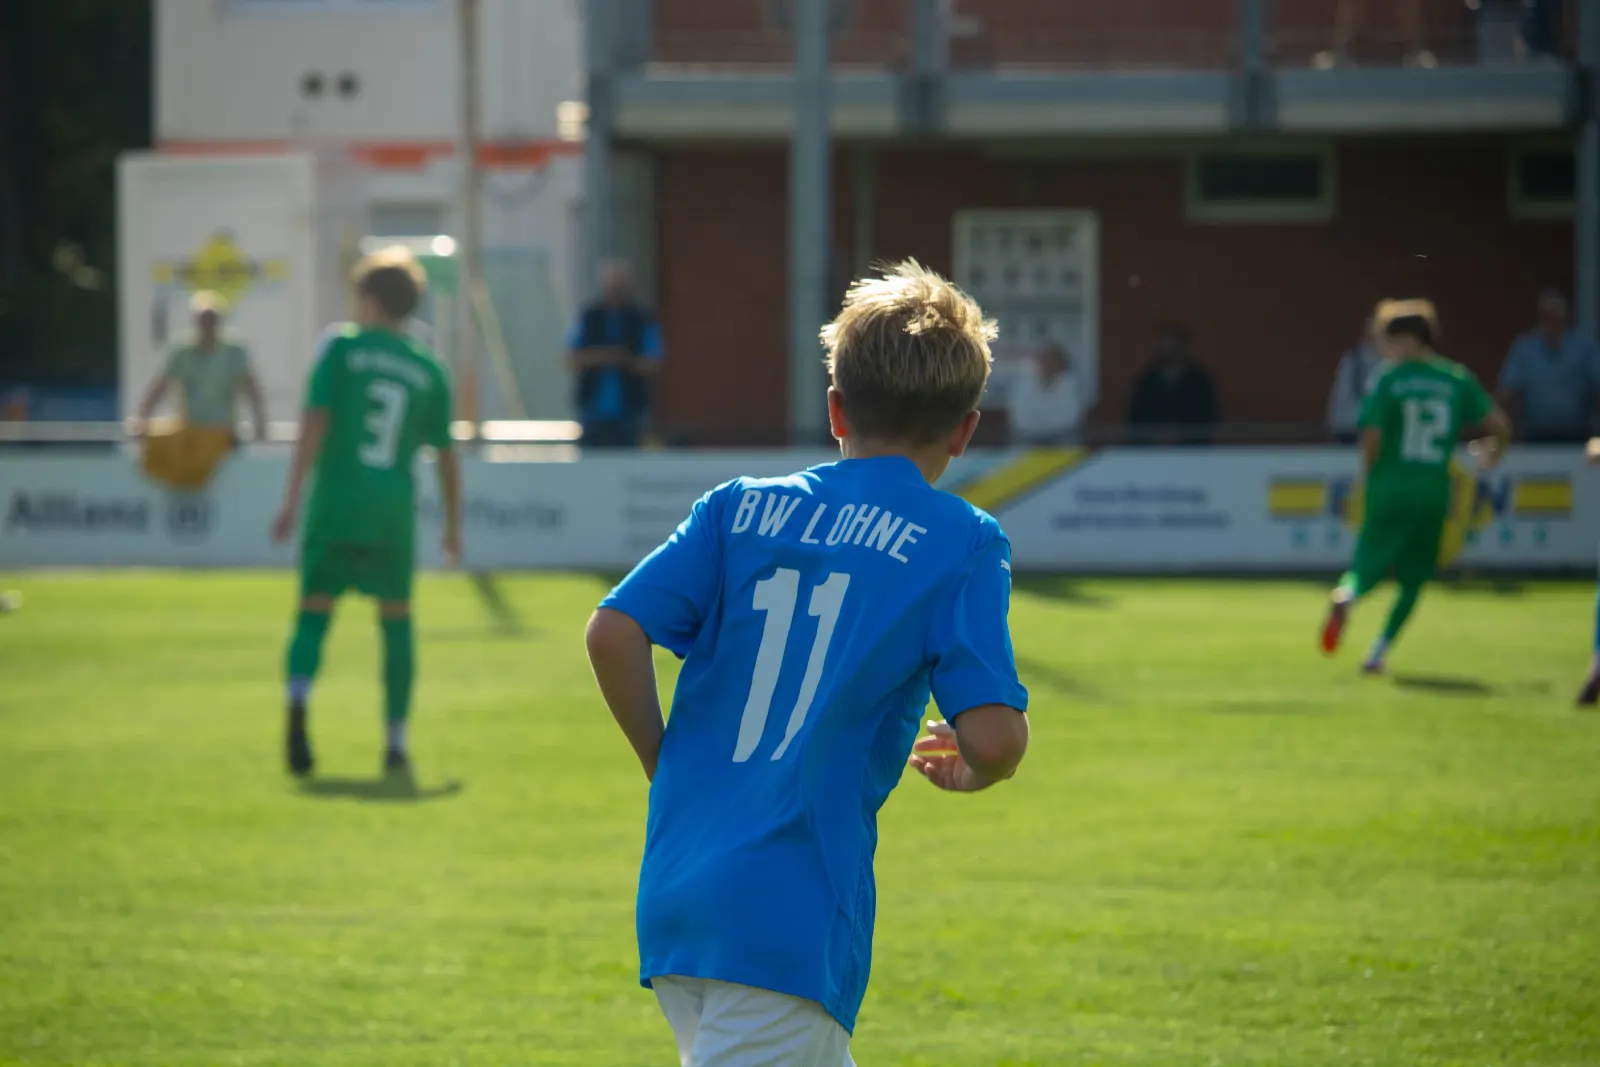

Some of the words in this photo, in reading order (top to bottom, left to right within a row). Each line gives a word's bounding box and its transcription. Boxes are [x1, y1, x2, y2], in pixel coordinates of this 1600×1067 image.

[357, 377, 408, 469] 3
[1401, 398, 1451, 462] 12
[6, 492, 149, 533] Allianz
[731, 488, 802, 538] BW
[800, 502, 928, 564] LOHNE
[732, 567, 850, 763] 11
